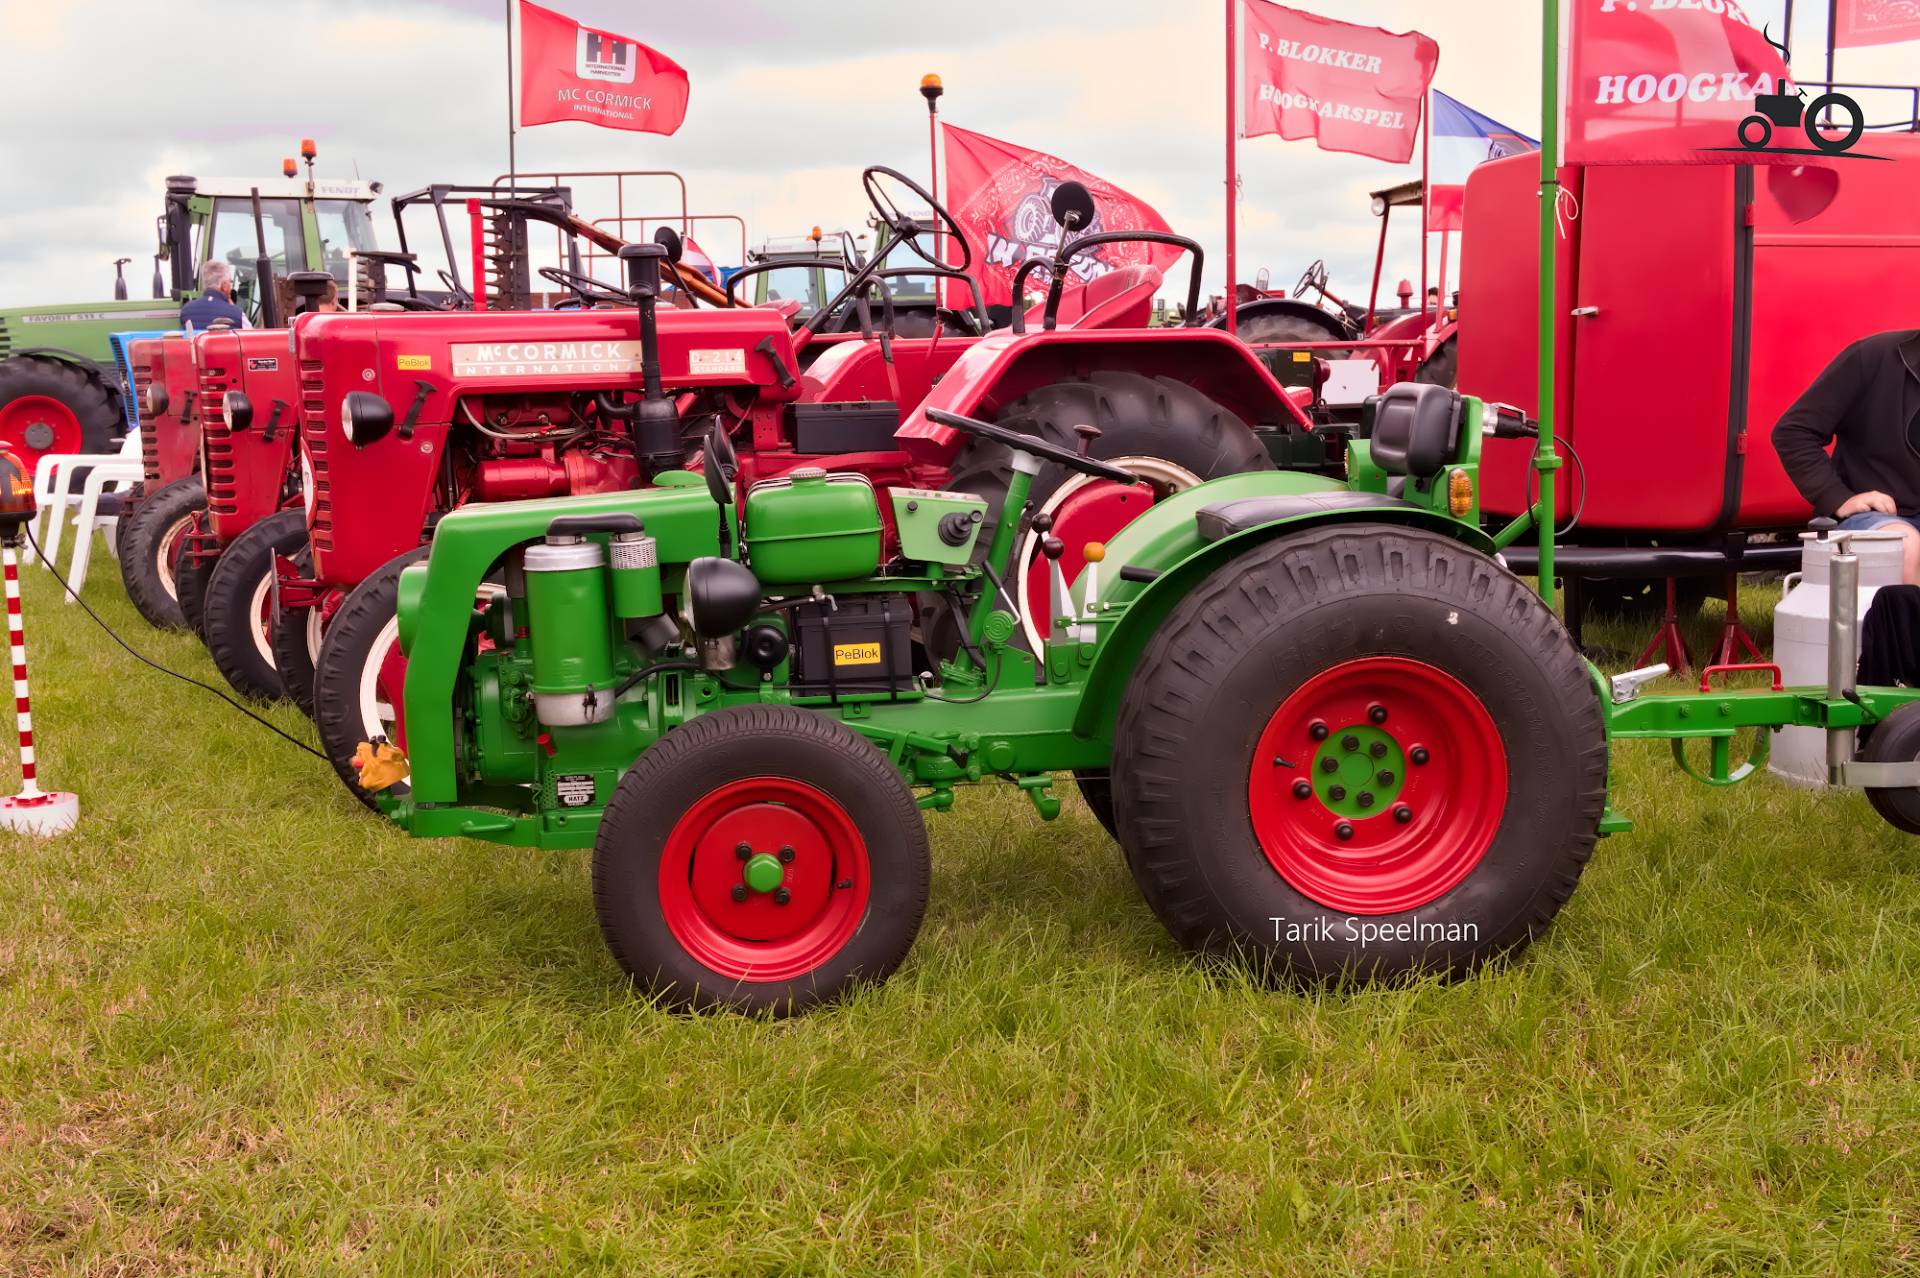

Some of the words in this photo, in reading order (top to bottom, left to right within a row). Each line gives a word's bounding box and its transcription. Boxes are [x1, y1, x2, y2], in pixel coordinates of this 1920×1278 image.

[1259, 32, 1274, 53] P.
[1277, 39, 1383, 74] BLOKKER
[558, 88, 581, 102] MC
[585, 89, 652, 111] CORMICK
[1259, 83, 1406, 129] HOOGKARSPEL
[573, 103, 633, 120] INTERNATIONAL
[835, 648, 879, 660] PeBlok
